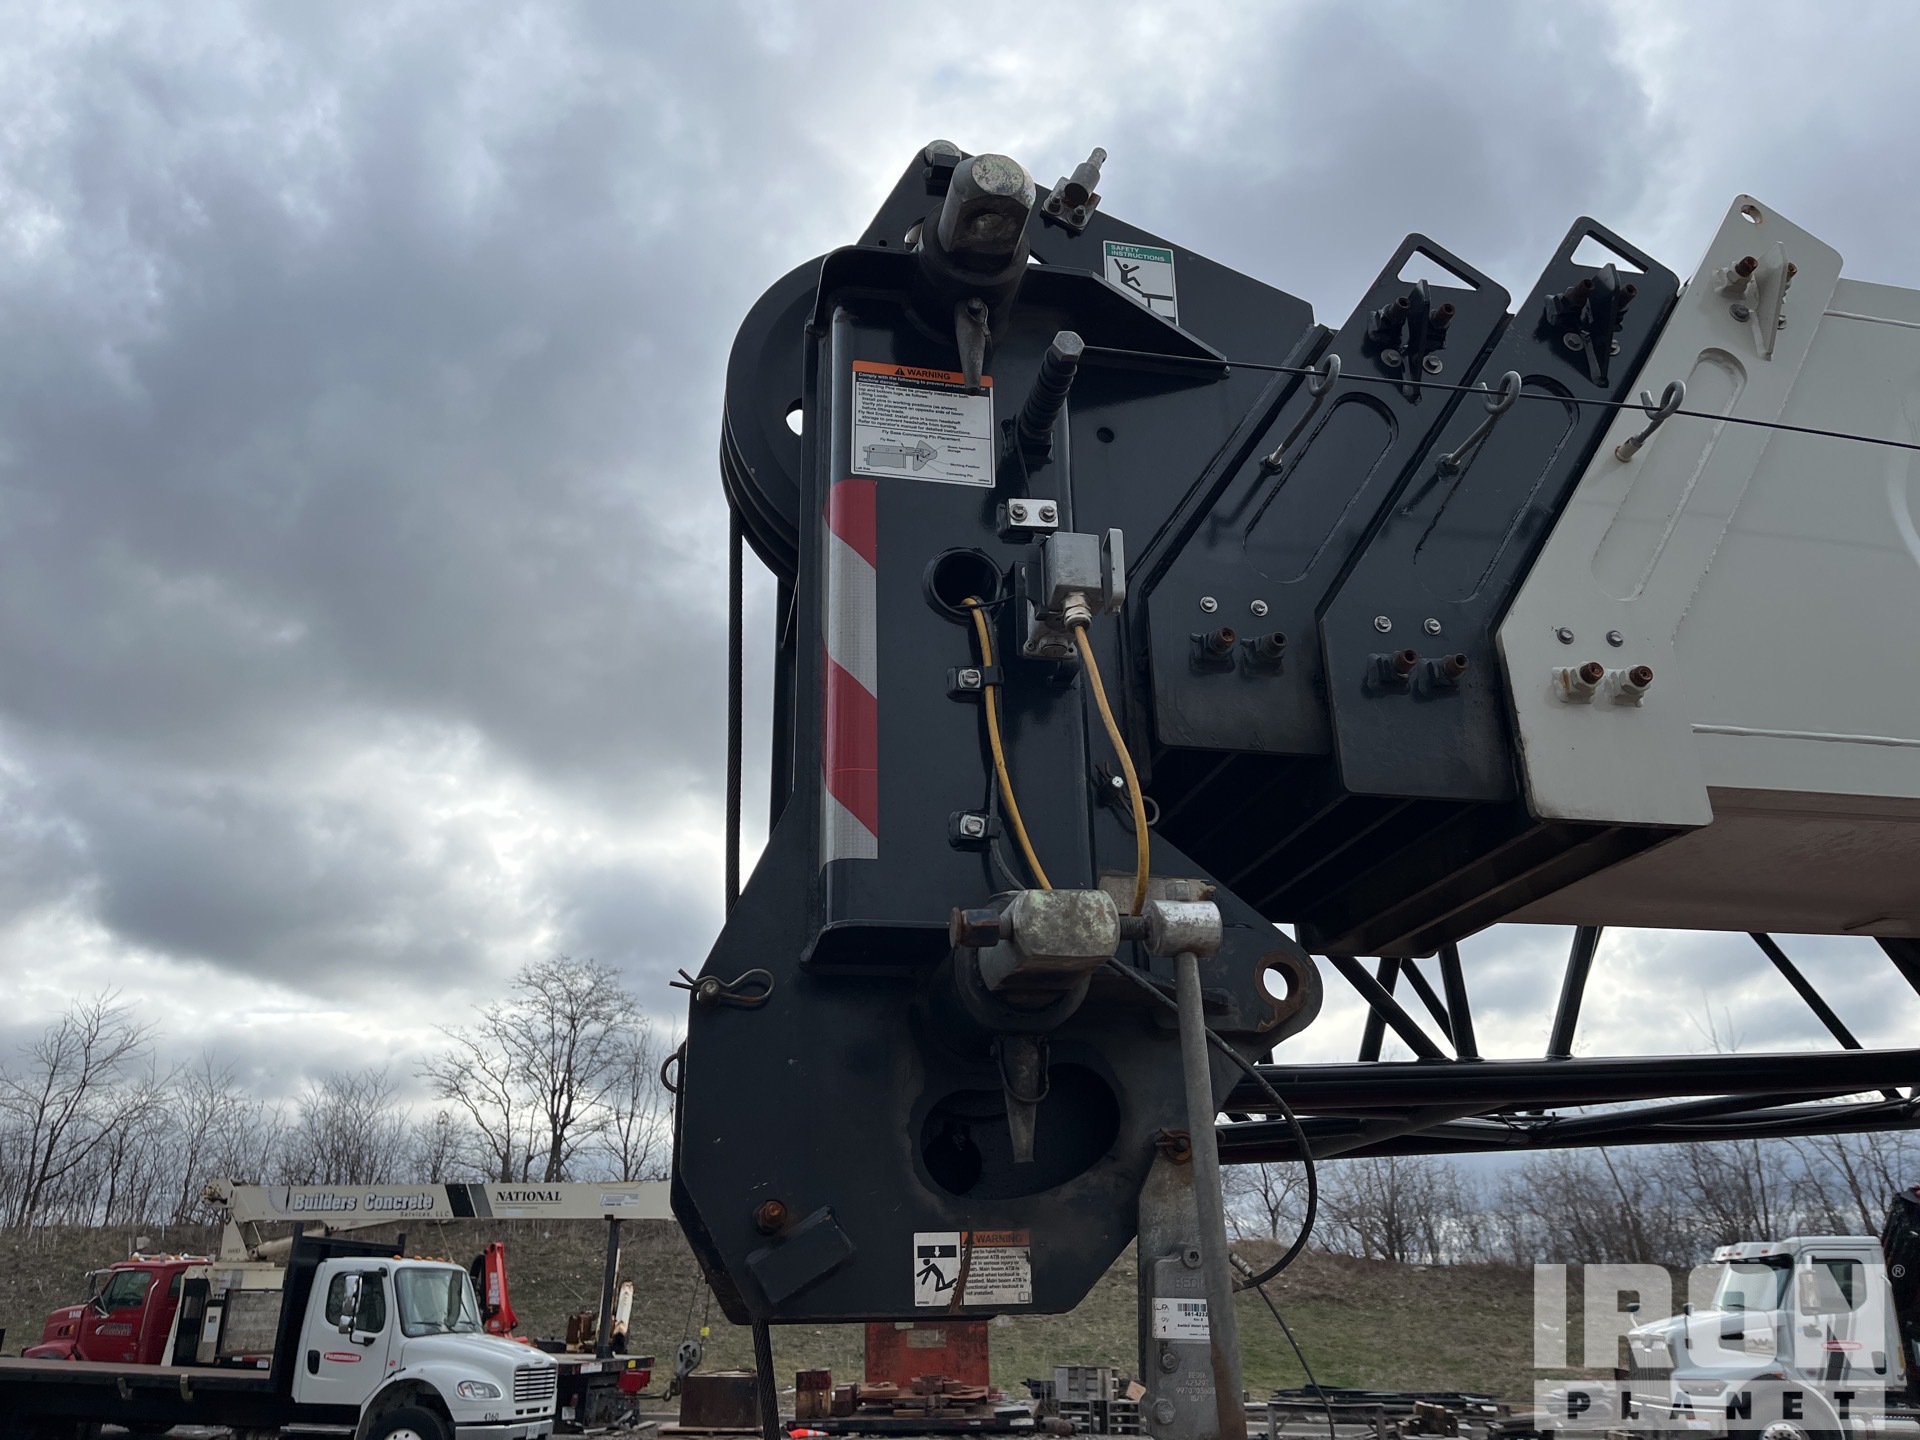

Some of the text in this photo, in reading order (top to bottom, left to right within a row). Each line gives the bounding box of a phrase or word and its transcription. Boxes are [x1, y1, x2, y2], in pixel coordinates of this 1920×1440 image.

[1111, 250, 1165, 261] INSTRUCTIONS
[908, 369, 950, 380] WARNING
[293, 1192, 357, 1211] Builders
[364, 1192, 434, 1210] Concrete
[496, 1191, 562, 1201] NATIONAL
[976, 1234, 1022, 1243] WARNING
